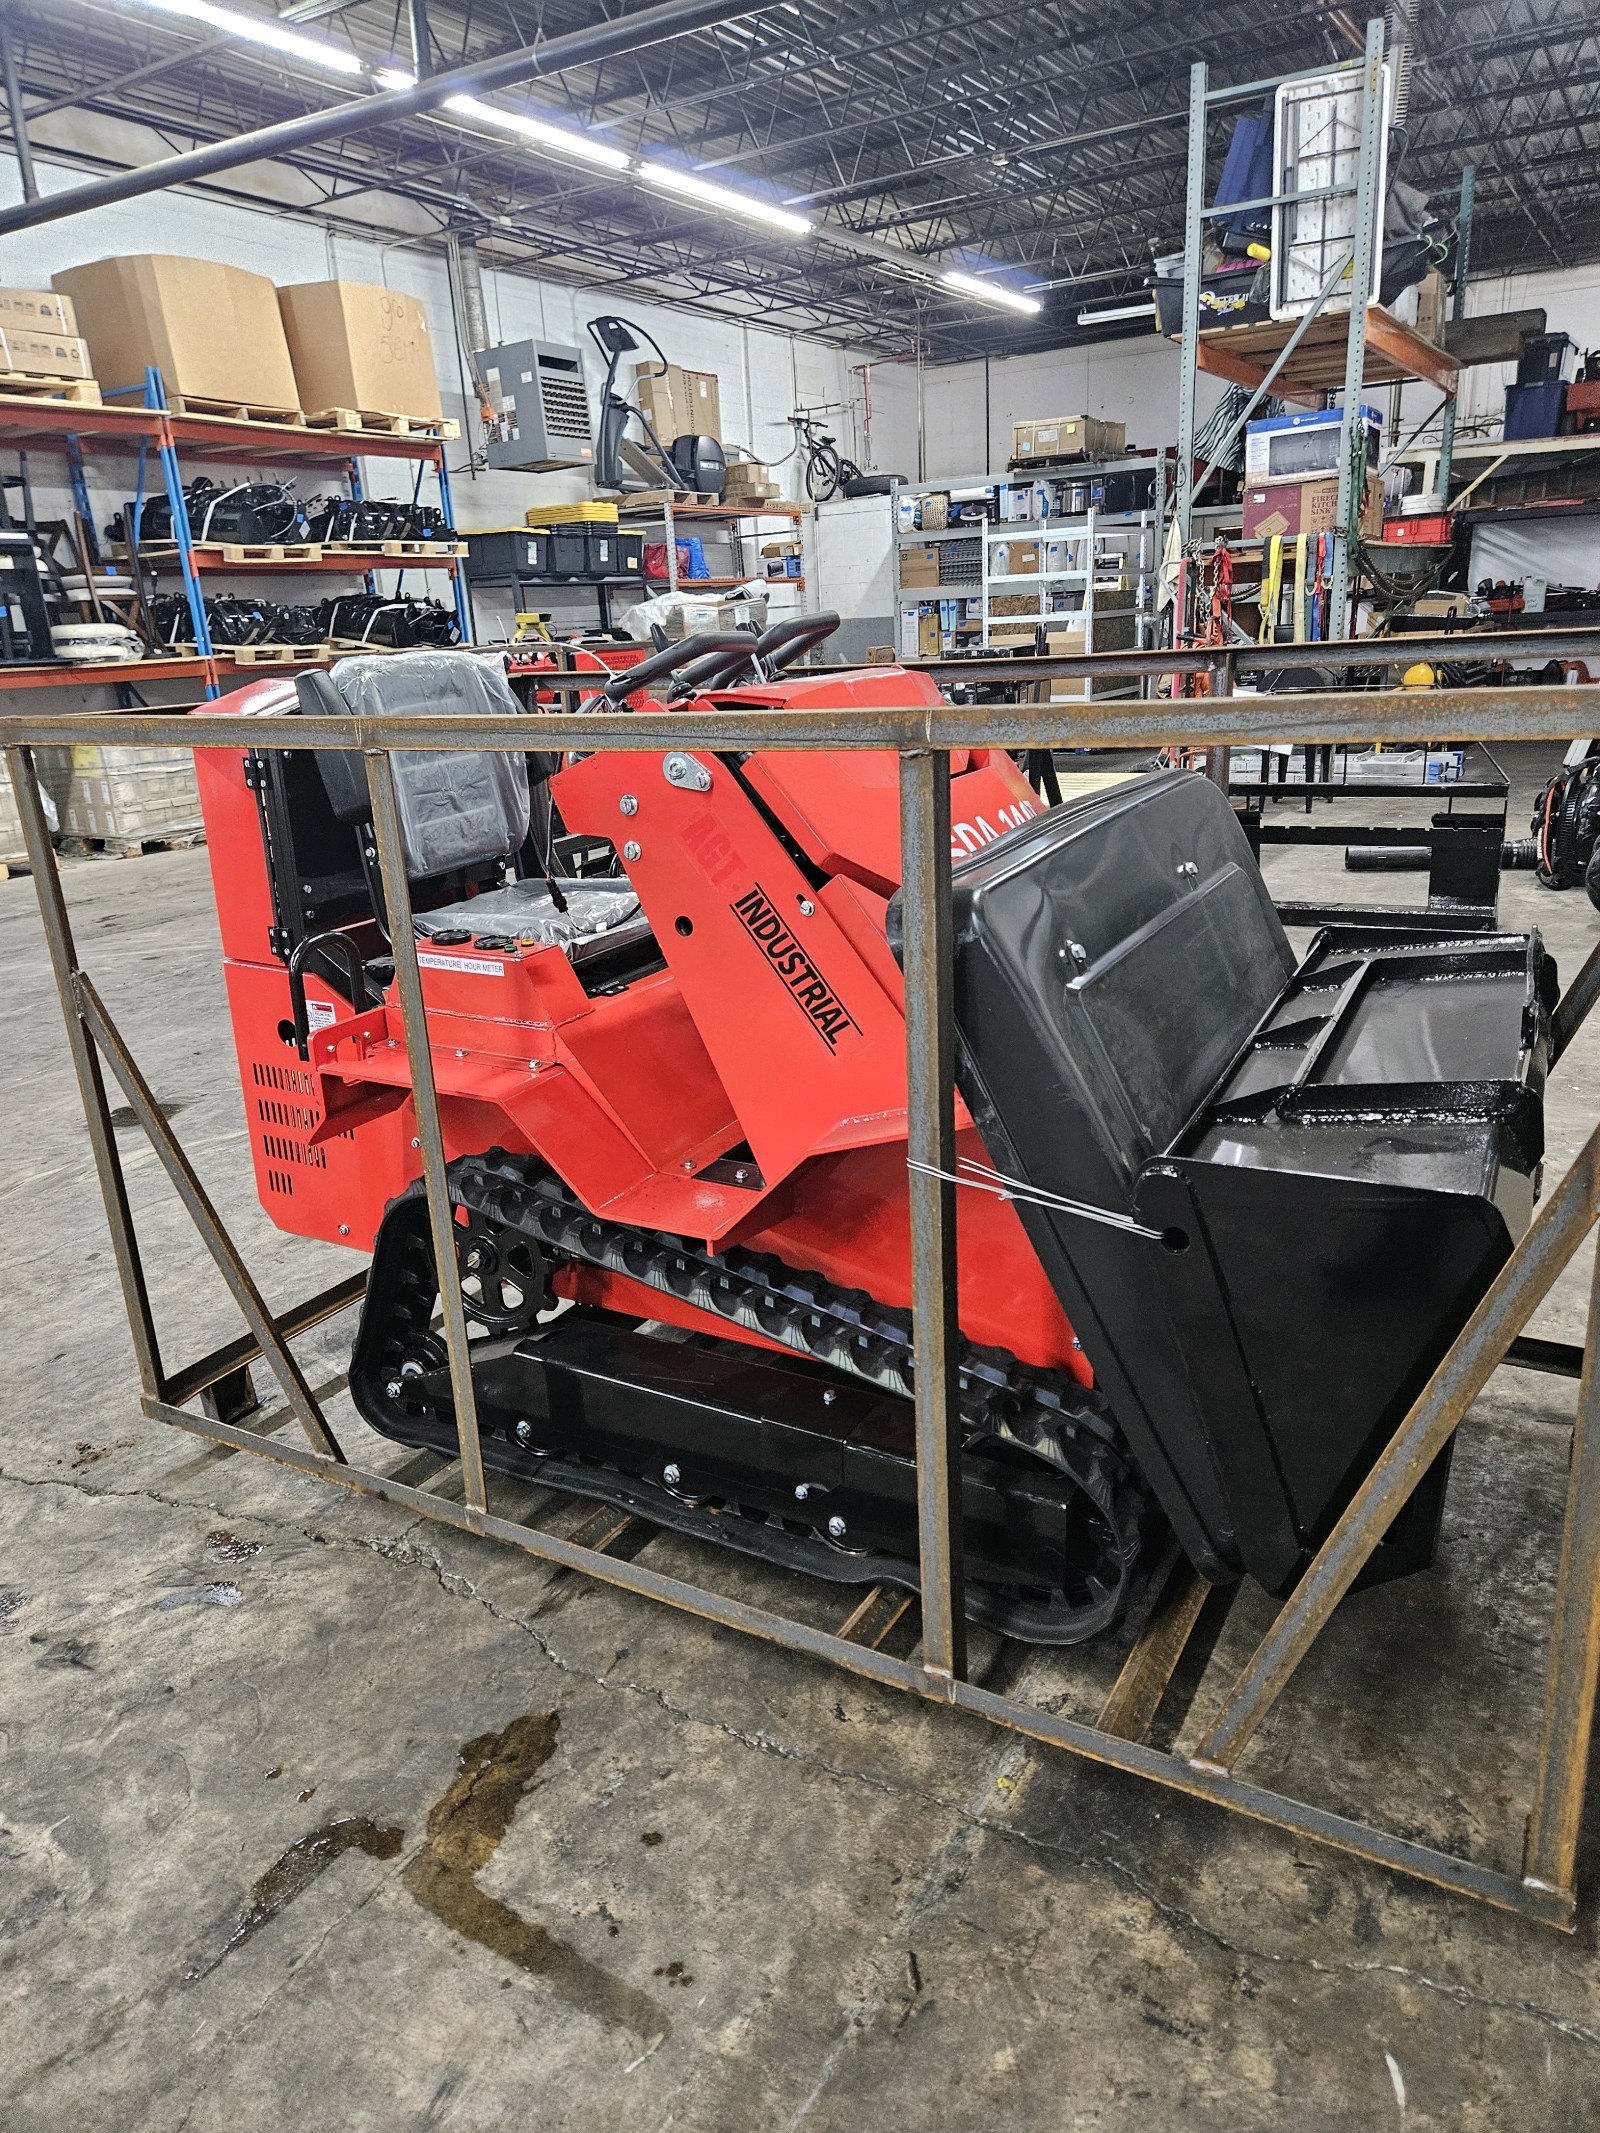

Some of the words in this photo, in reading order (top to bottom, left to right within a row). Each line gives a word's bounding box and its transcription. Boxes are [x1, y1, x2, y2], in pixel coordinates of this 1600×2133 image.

[687, 374, 695, 435] COUNTERTOP
[1311, 508, 1331, 516] SINK
[418, 956, 462, 969] TEMPERATURE
[463, 961, 482, 971] HOUR
[482, 963, 504, 974] METER
[735, 889, 851, 1045] INDUSTRIAL
